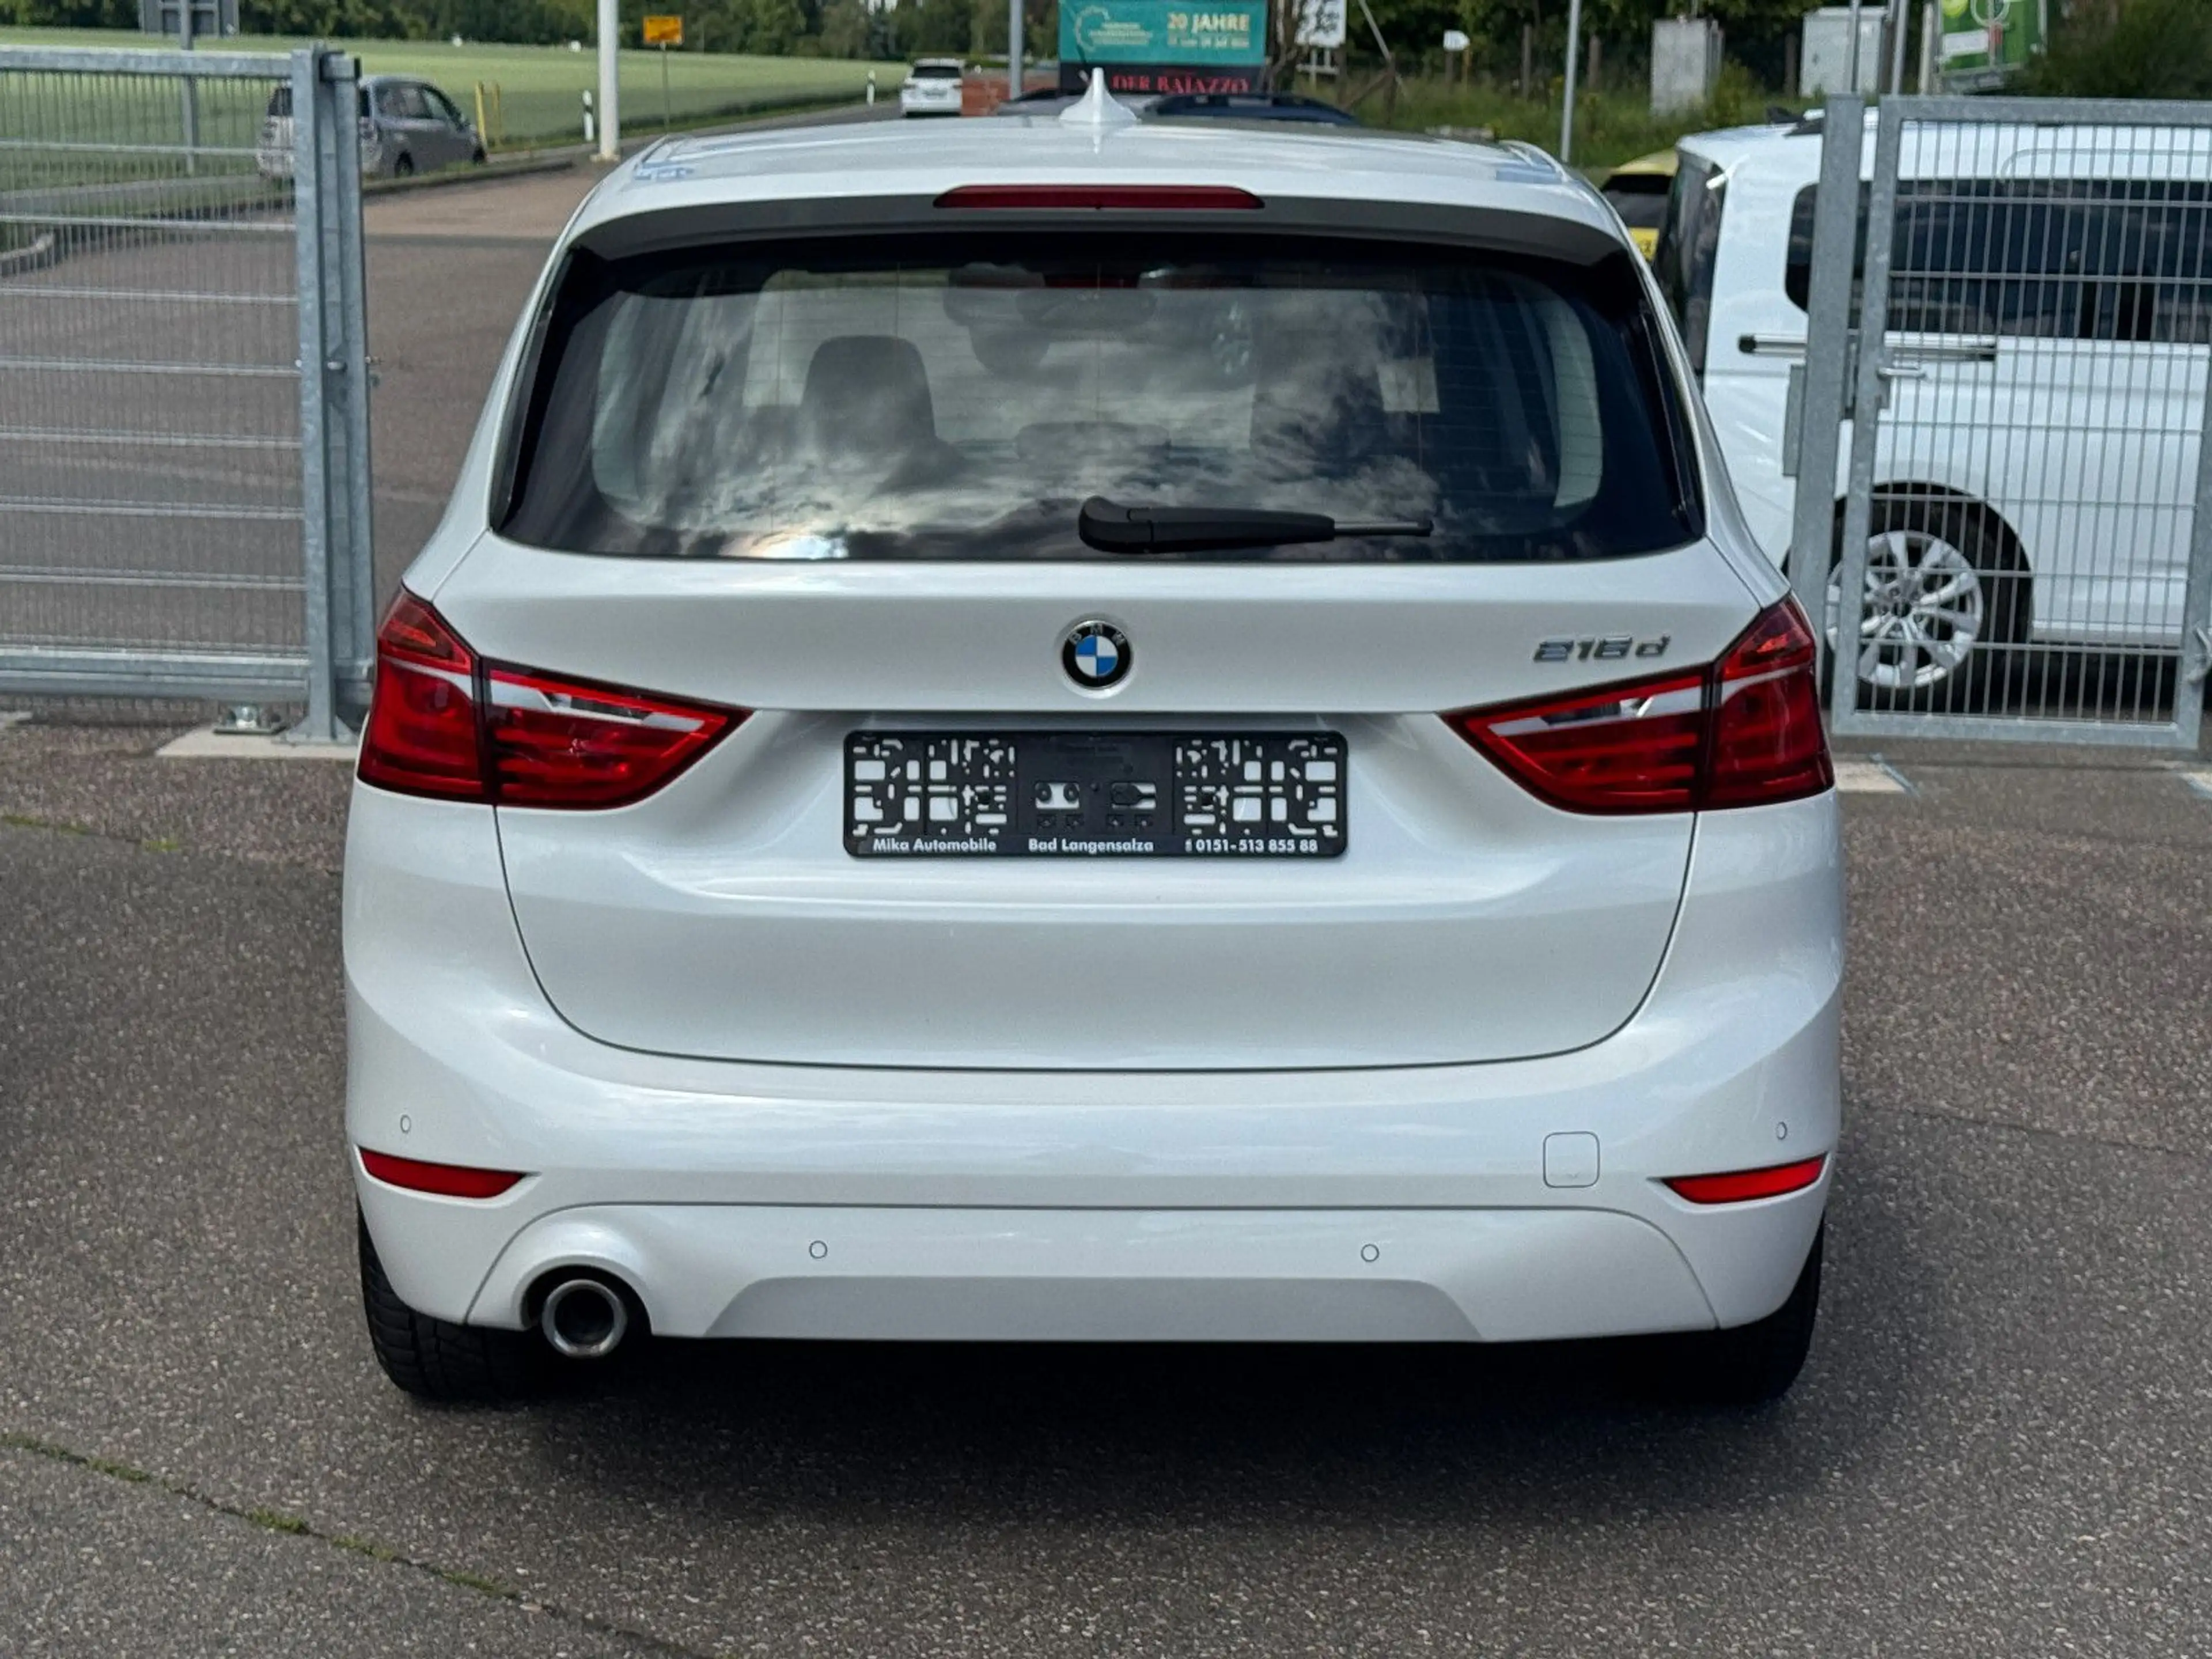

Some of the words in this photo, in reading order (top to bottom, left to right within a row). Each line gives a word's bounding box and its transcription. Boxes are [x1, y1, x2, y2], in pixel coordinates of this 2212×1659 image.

[1168, 13, 1187, 30] 20
[1191, 13, 1249, 33] JAHRE
[873, 838, 910, 853] Mika
[913, 838, 997, 853] Automobile
[1028, 838, 1057, 852] Bad
[1062, 838, 1154, 854] Langensalza
[1268, 839, 1296, 853] 855
[1299, 839, 1319, 853] 88
